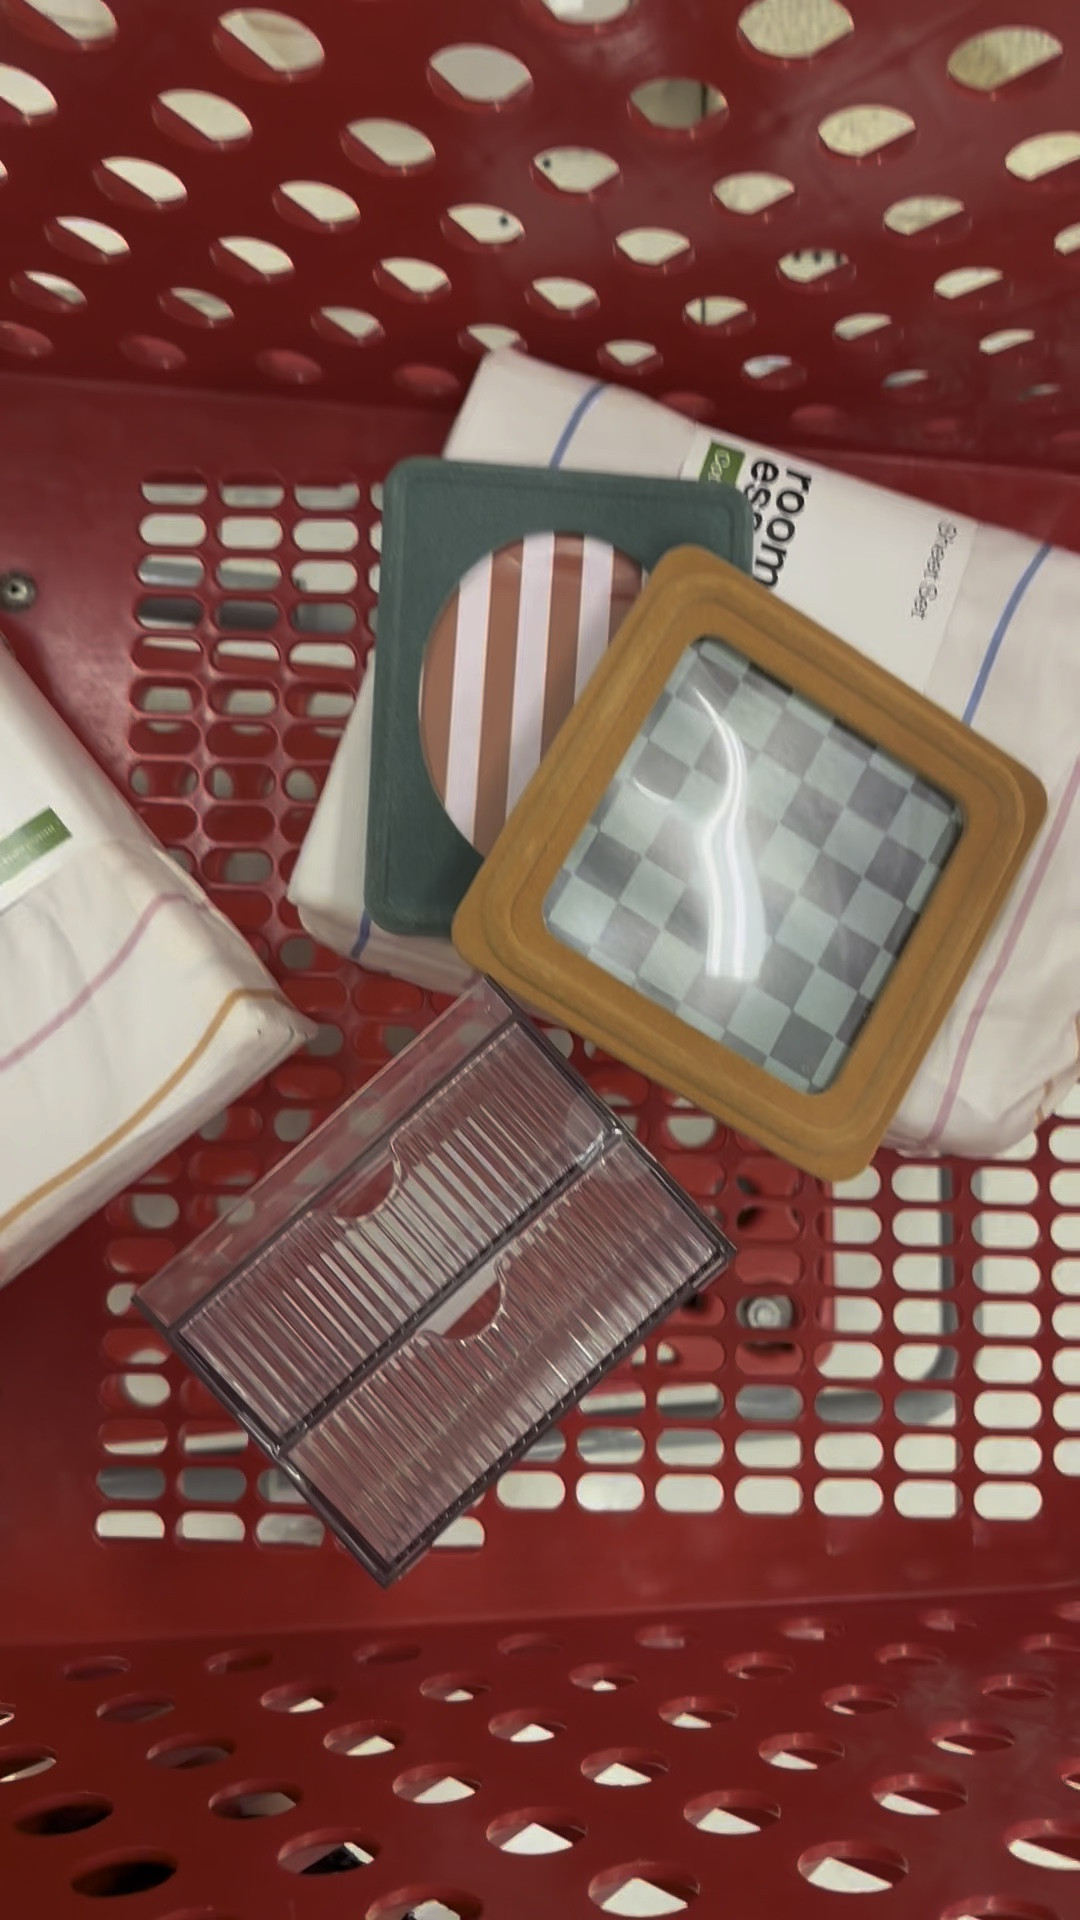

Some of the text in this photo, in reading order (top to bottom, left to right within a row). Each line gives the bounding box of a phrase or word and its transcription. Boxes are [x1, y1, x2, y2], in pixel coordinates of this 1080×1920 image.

[753, 468, 812, 587] room
[911, 520, 957, 621] Sheet Set
